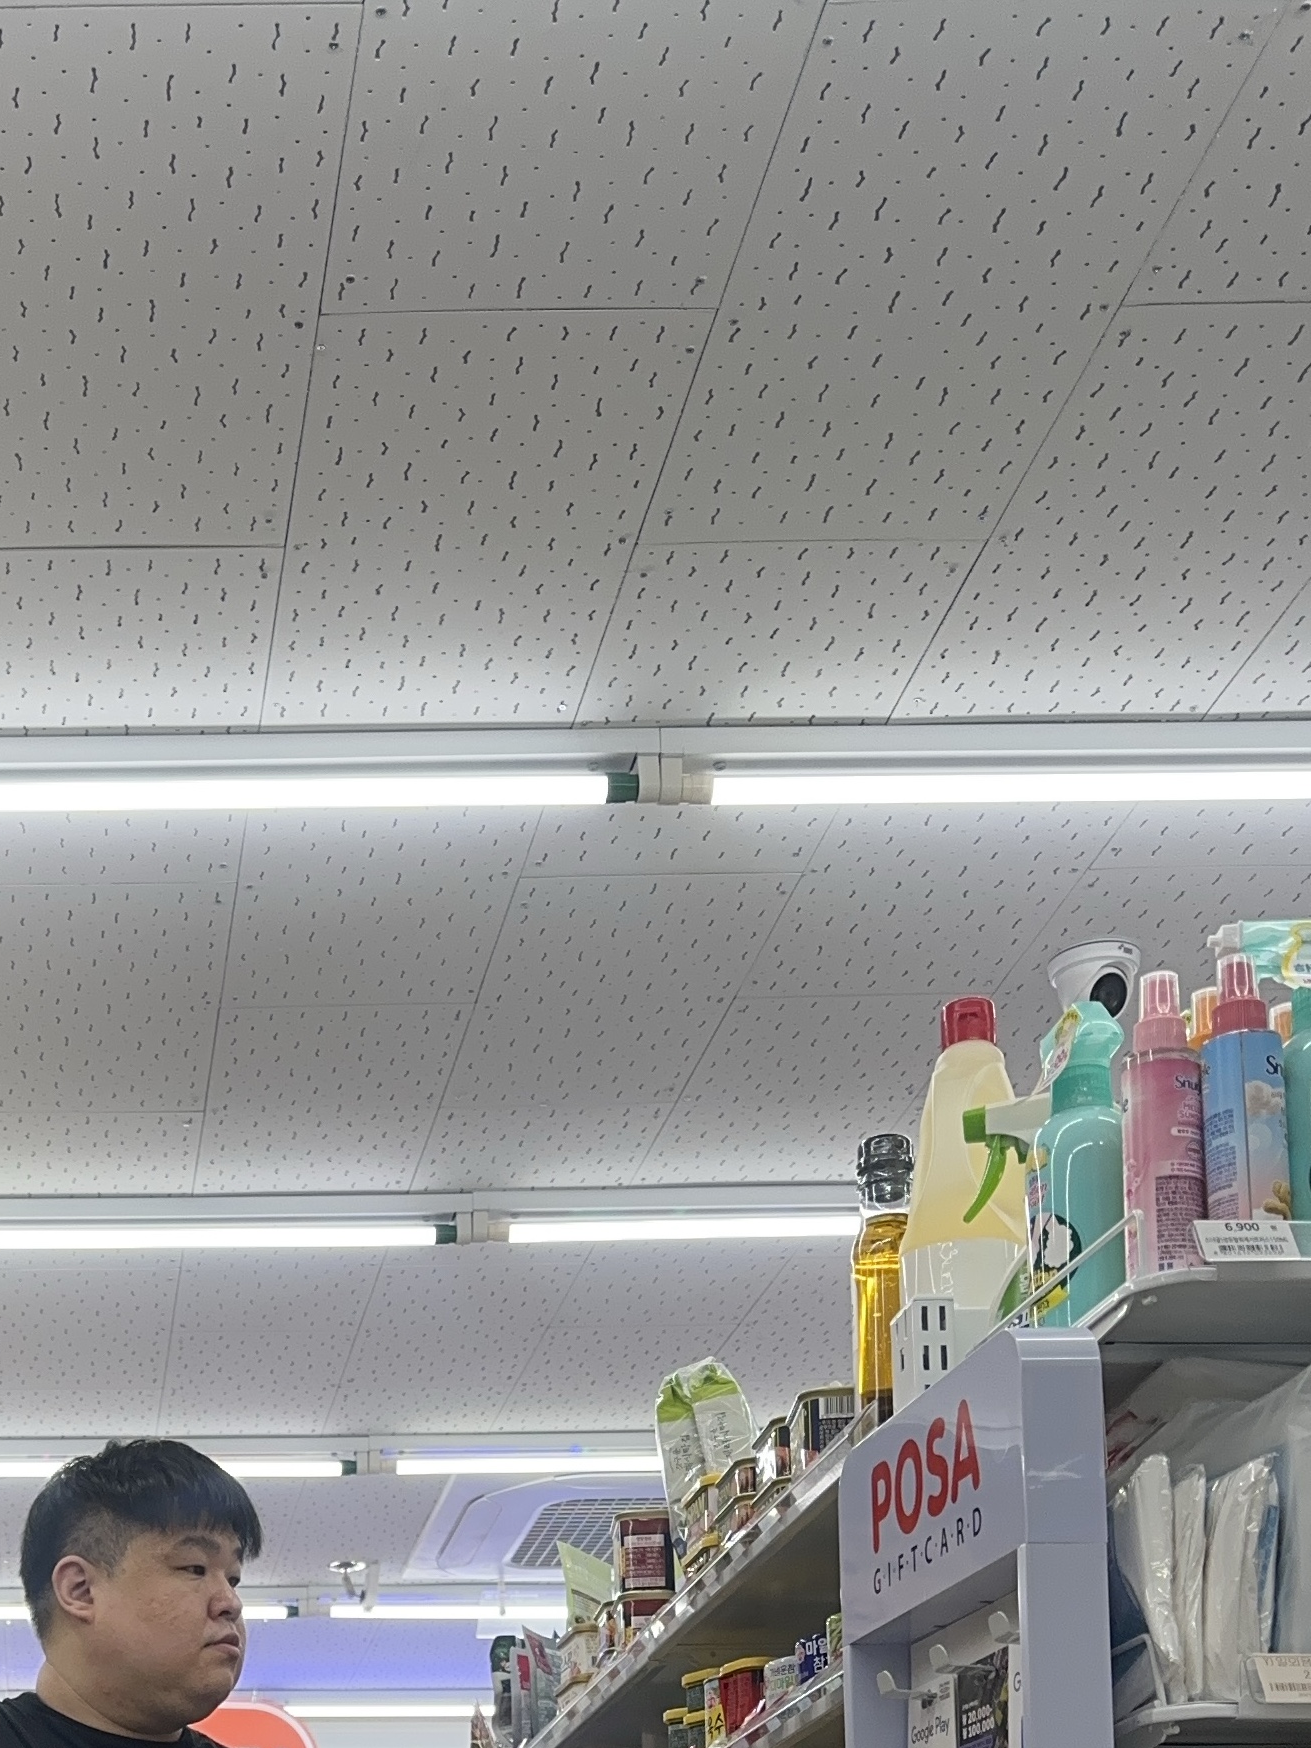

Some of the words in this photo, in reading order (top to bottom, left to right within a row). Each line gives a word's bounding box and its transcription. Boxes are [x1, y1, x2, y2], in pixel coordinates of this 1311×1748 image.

[870, 1398, 981, 1555] POSA
[805, 1637, 827, 1657] 마일
[911, 1720, 935, 1745] Google
[935, 1715, 951, 1736] Play
